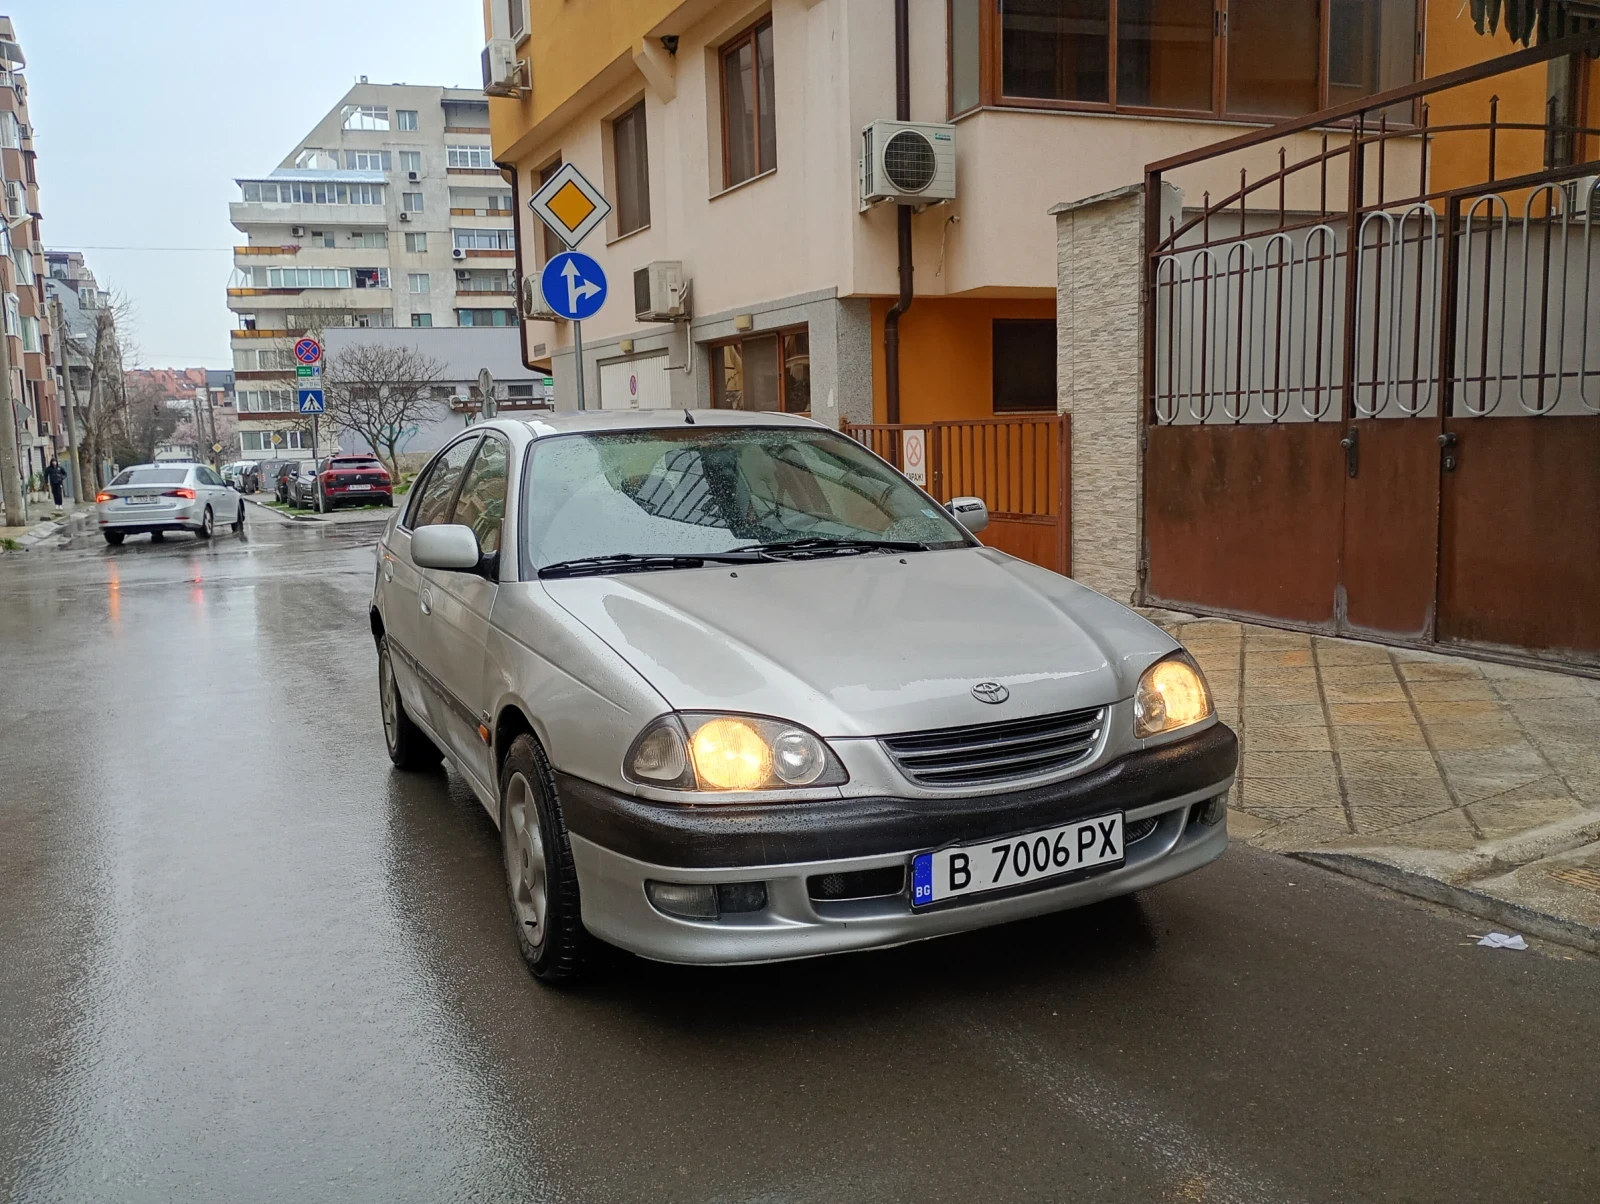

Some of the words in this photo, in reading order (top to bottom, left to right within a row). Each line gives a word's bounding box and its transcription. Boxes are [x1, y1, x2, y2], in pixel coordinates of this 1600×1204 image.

[949, 853, 971, 891] B
[991, 831, 1070, 883] 7006
[1077, 819, 1117, 863] PX
[916, 884, 931, 898] BG
